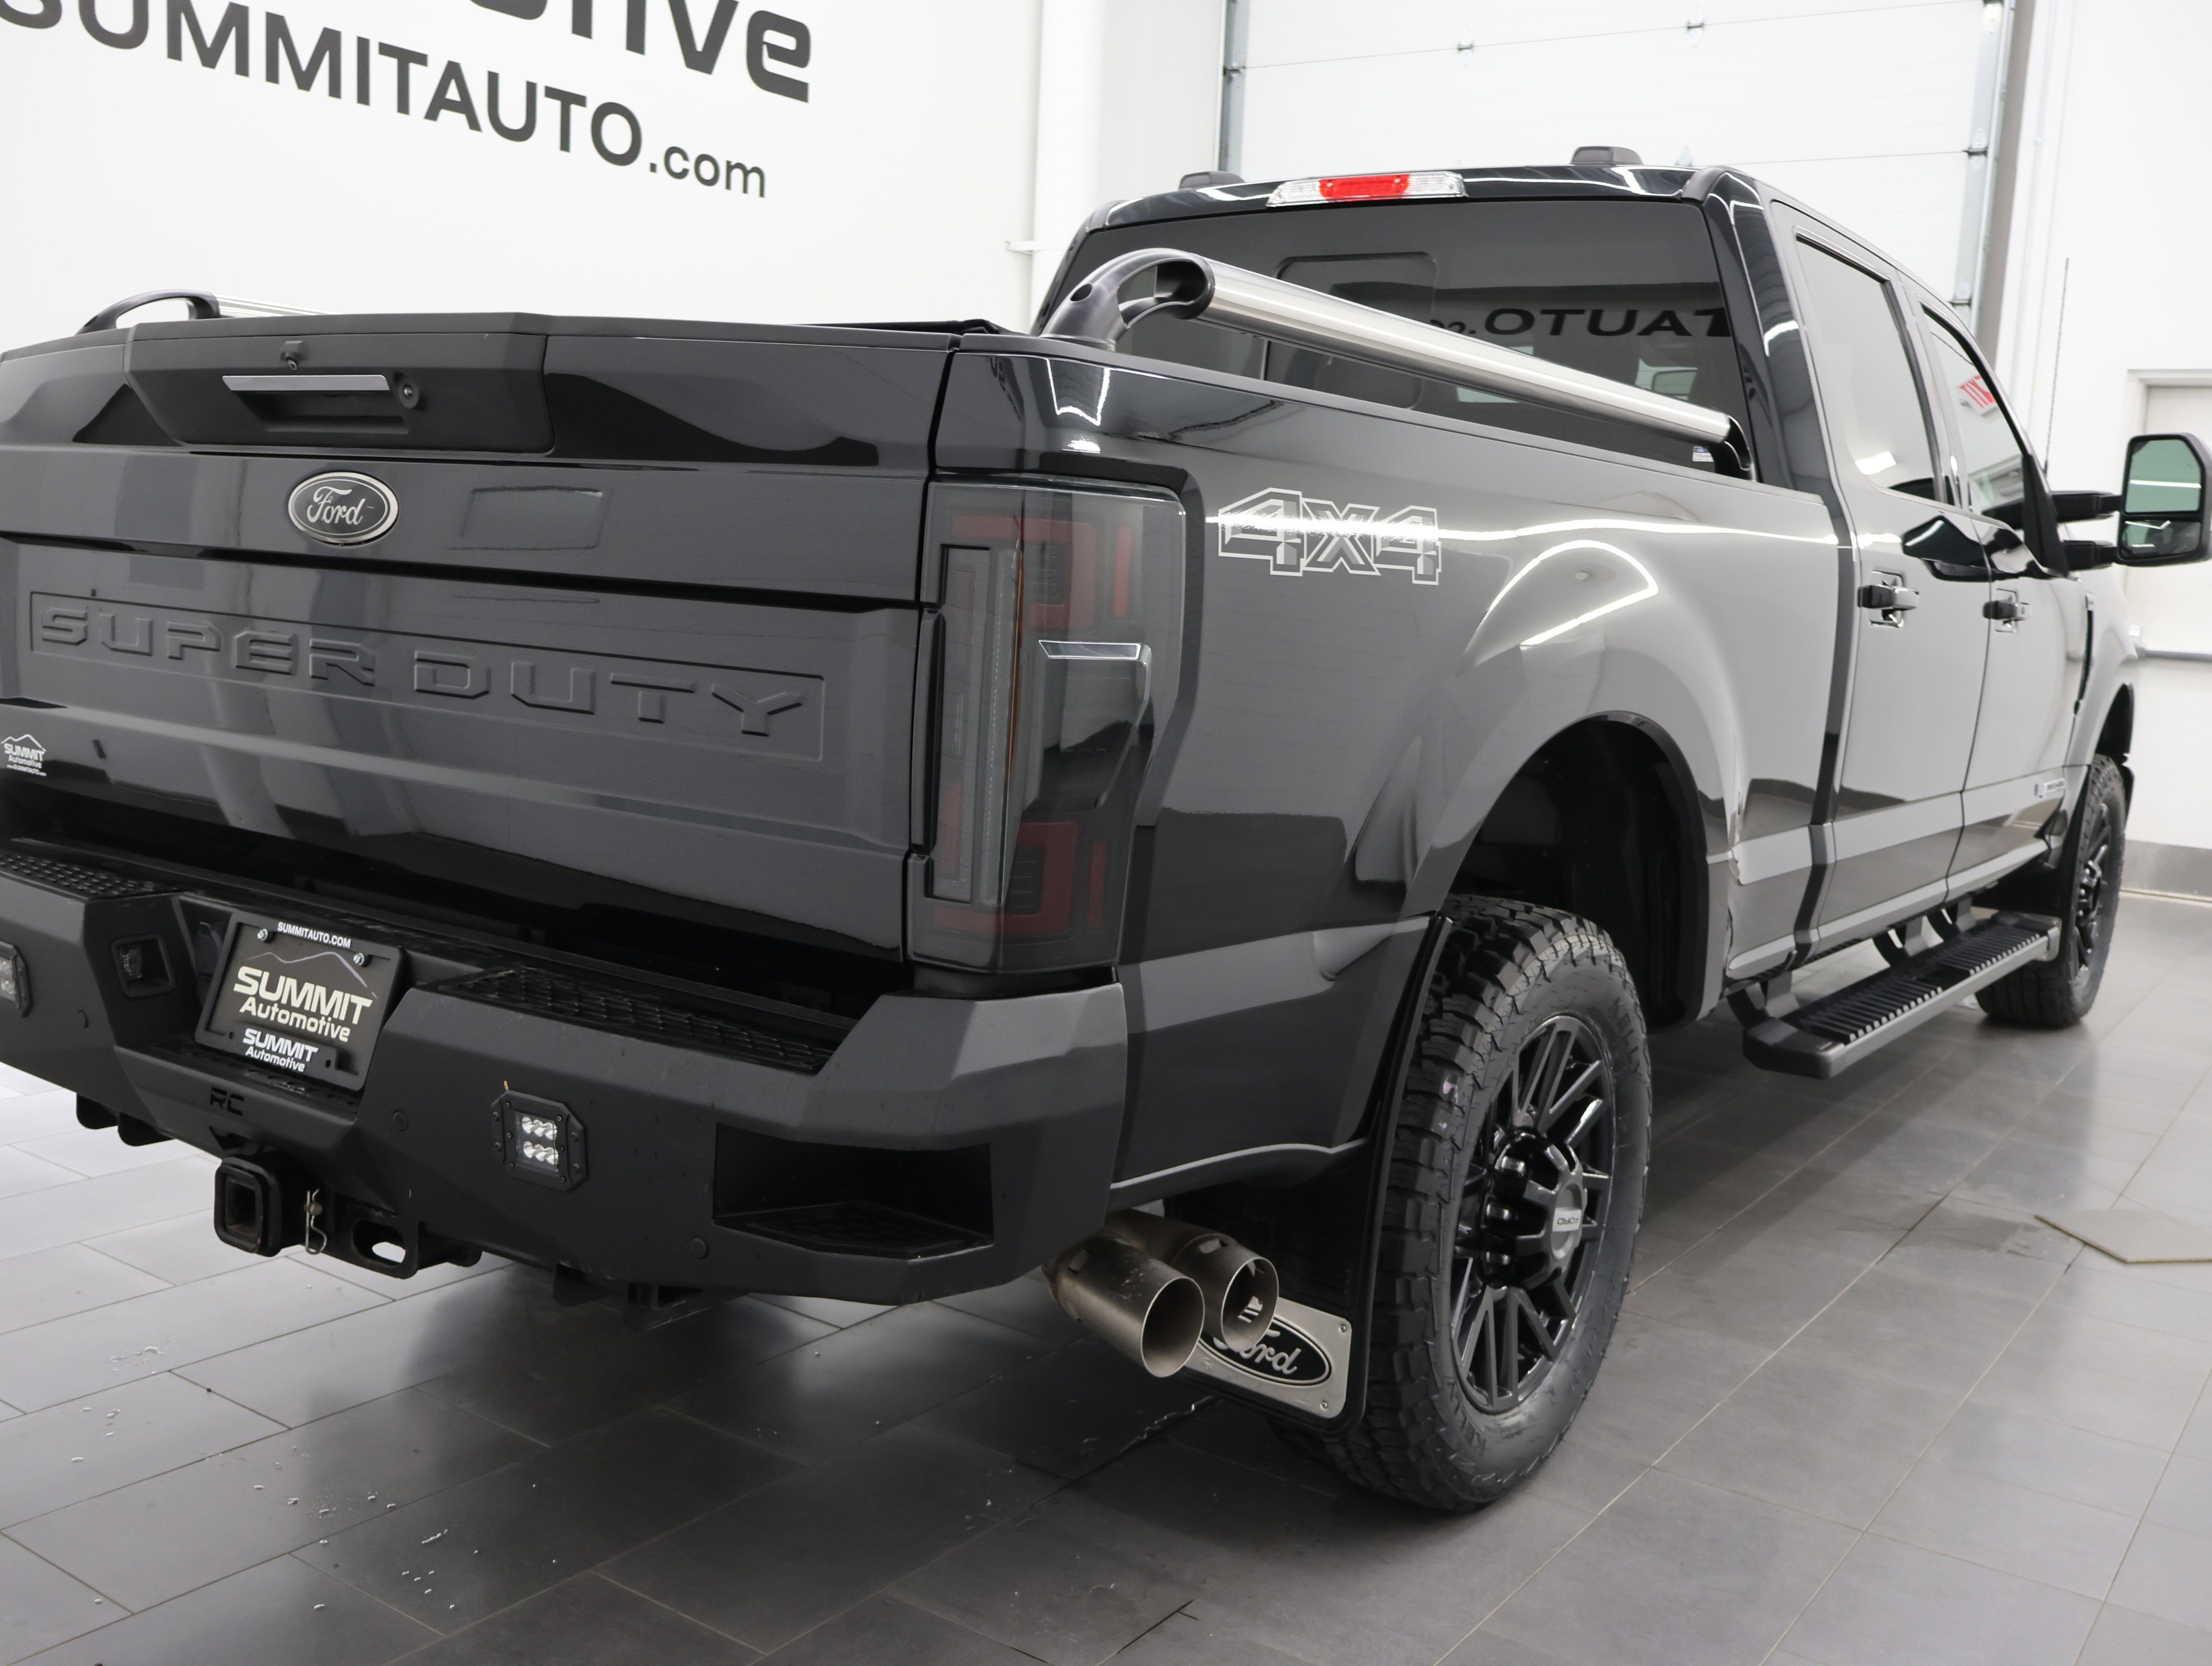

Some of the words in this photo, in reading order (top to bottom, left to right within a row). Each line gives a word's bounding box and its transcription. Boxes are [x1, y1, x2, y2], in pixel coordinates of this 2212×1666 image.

[307, 486, 366, 525] Ford
[1218, 487, 1442, 585] 4X4
[41, 607, 375, 687] SUPER
[414, 650, 803, 737] DUTY
[4, 743, 45, 762] SUMMIT
[277, 922, 351, 948] SUMMITAUTO.COM
[233, 966, 373, 1025] SUMMIT
[239, 997, 351, 1042] Automotive
[243, 1028, 319, 1062] SUMMIT
[245, 1046, 305, 1073] Automotive
